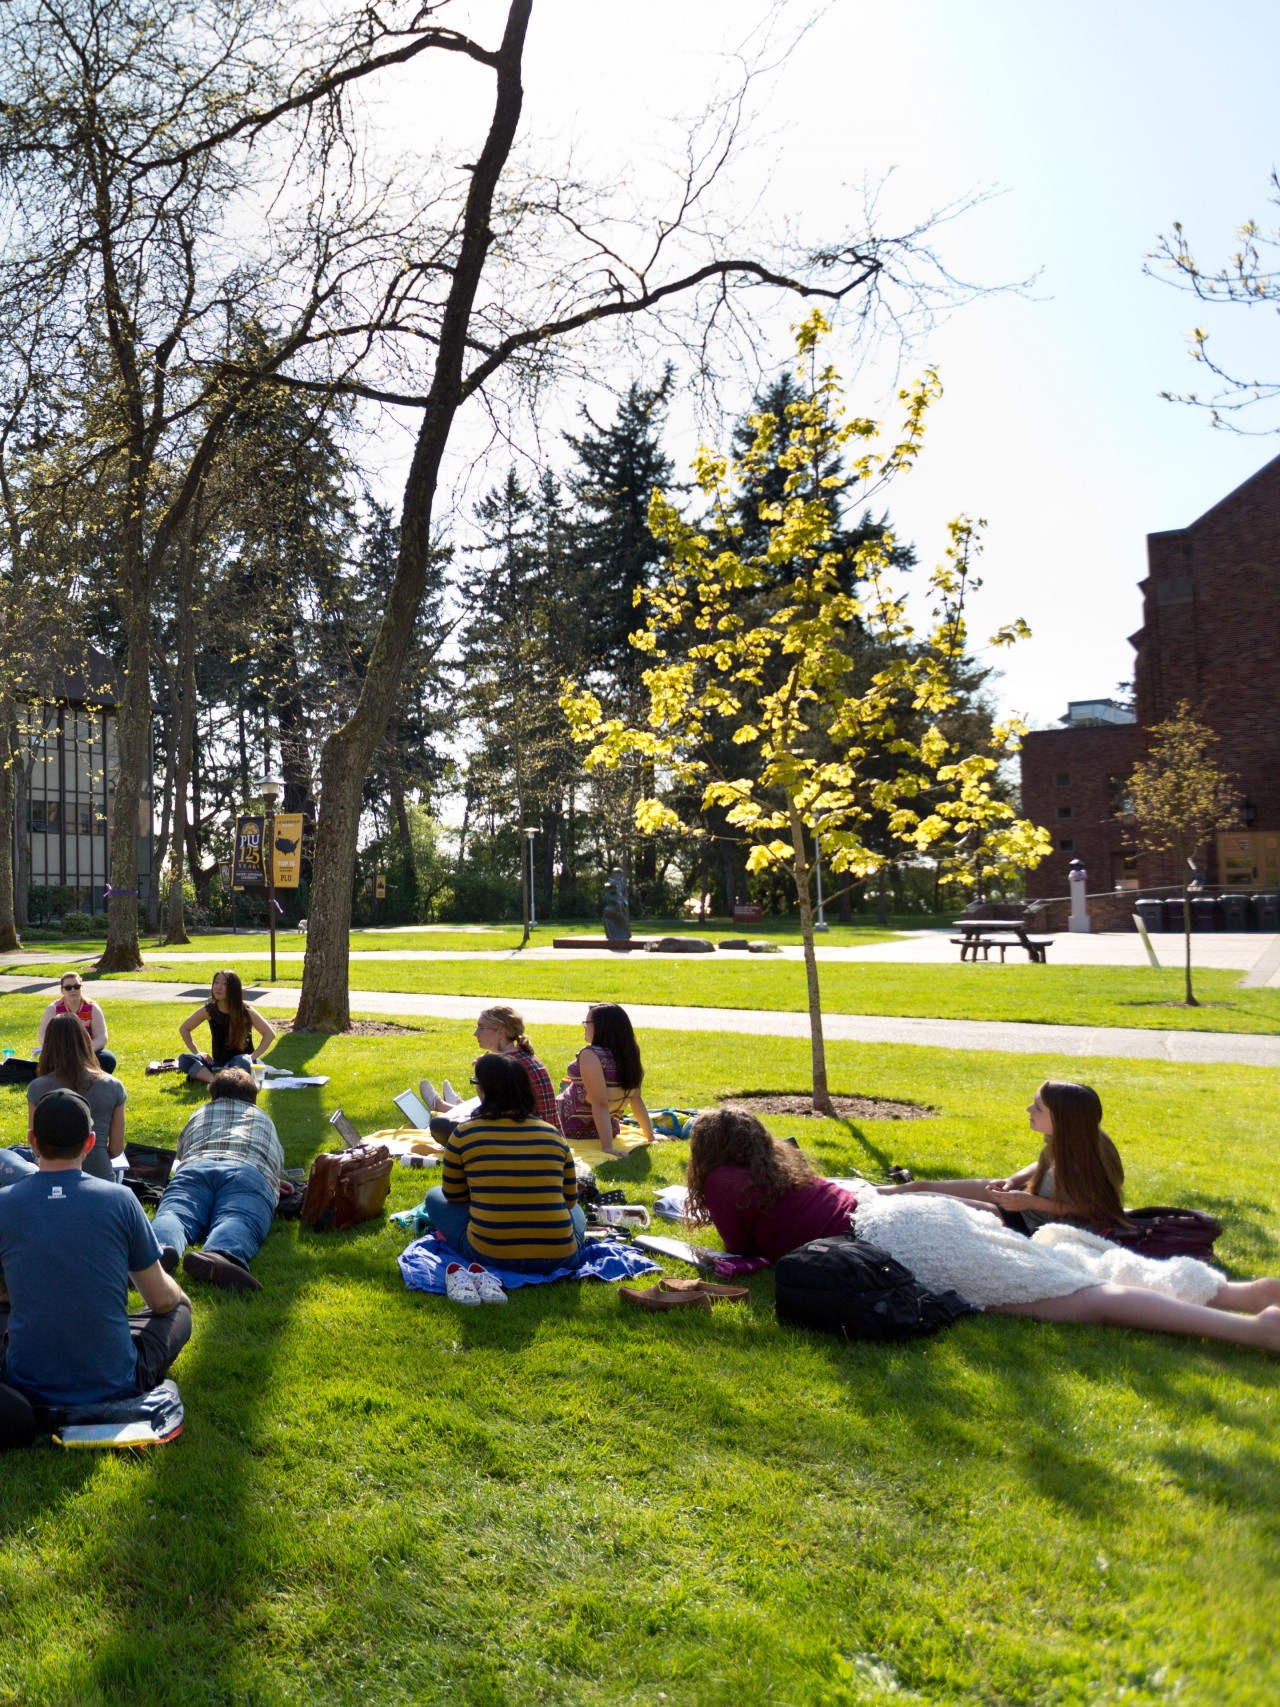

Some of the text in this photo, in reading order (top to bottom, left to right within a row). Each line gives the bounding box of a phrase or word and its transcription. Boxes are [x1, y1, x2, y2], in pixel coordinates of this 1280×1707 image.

[240, 835, 260, 848] PLU
[238, 847, 260, 864] 125
[280, 874, 292, 882] PLU
